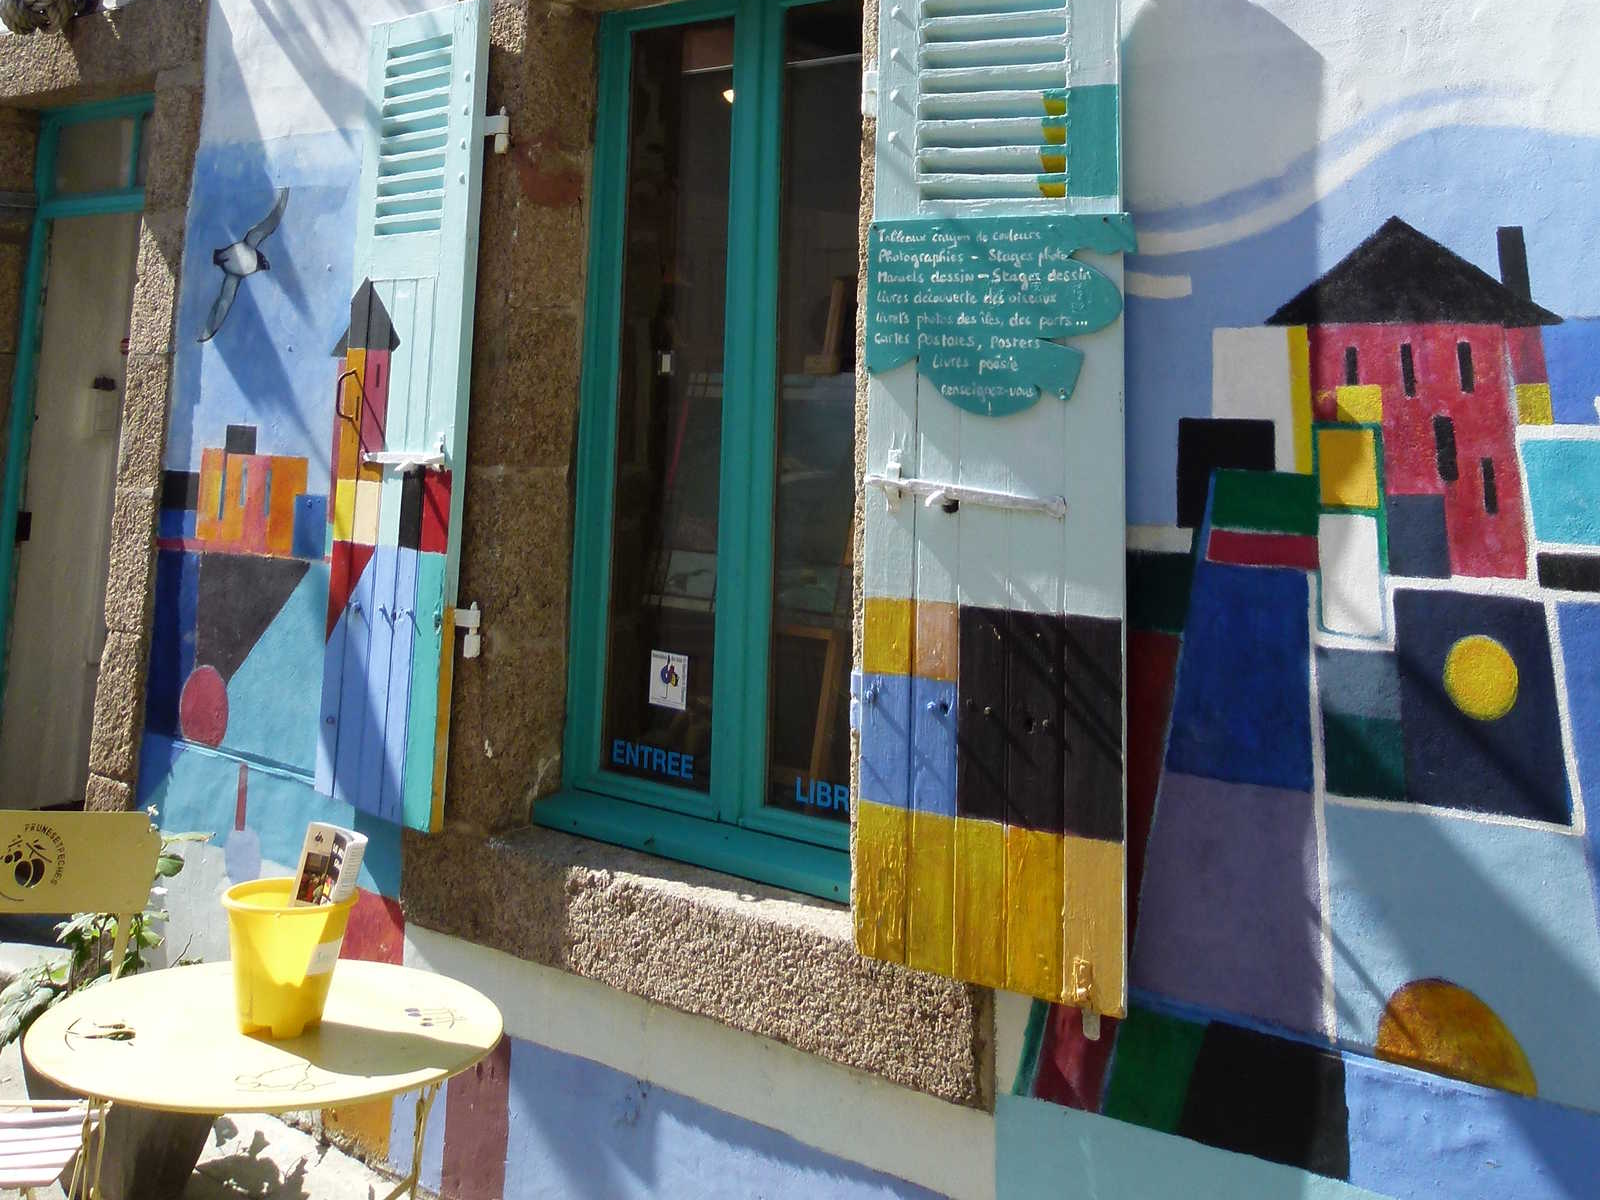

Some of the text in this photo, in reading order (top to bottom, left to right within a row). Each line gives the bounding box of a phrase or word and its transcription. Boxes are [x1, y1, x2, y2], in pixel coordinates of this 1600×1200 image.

[976, 232, 988, 242] de
[992, 231, 1040, 242] couleurs
[878, 250, 963, 267] Photographies
[988, 249, 1033, 267] Stages
[878, 272, 924, 283] Manuels
[930, 269, 974, 283] dessin
[1047, 268, 1091, 281] dessin
[1009, 294, 1056, 304] oiseaux
[957, 310, 977, 324] des
[1009, 311, 1031, 326] des
[612, 740, 694, 780] ENTREE
